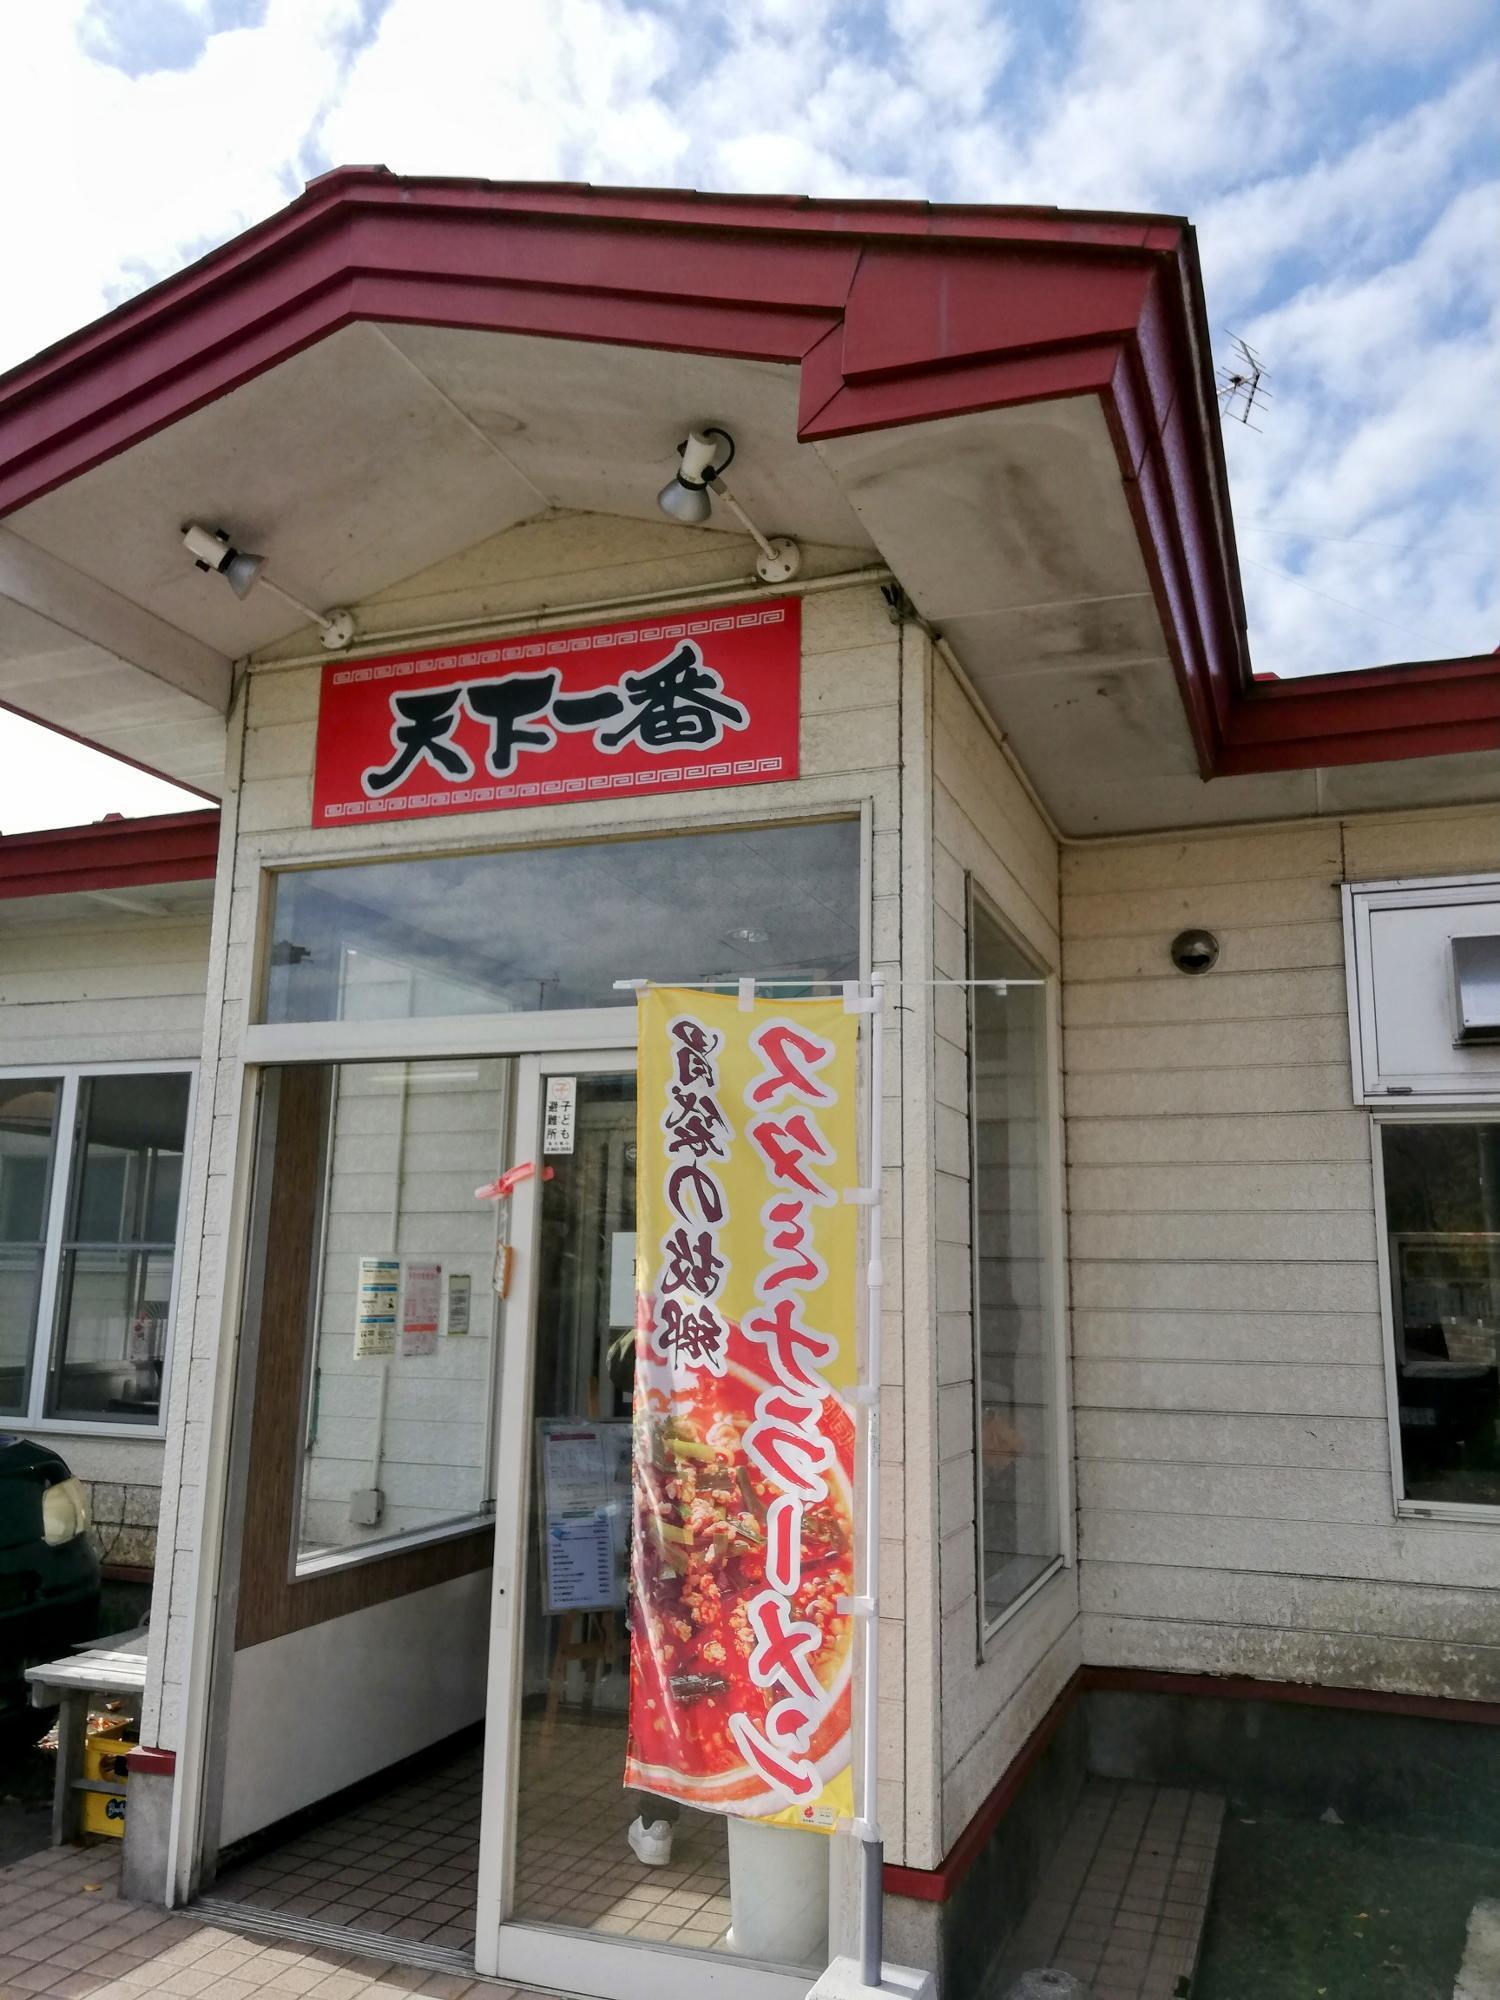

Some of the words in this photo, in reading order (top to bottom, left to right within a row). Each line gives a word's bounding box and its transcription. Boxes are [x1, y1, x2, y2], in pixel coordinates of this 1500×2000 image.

[366, 644, 748, 792] 天下一番
[560, 1100, 572, 1140] 子ども
